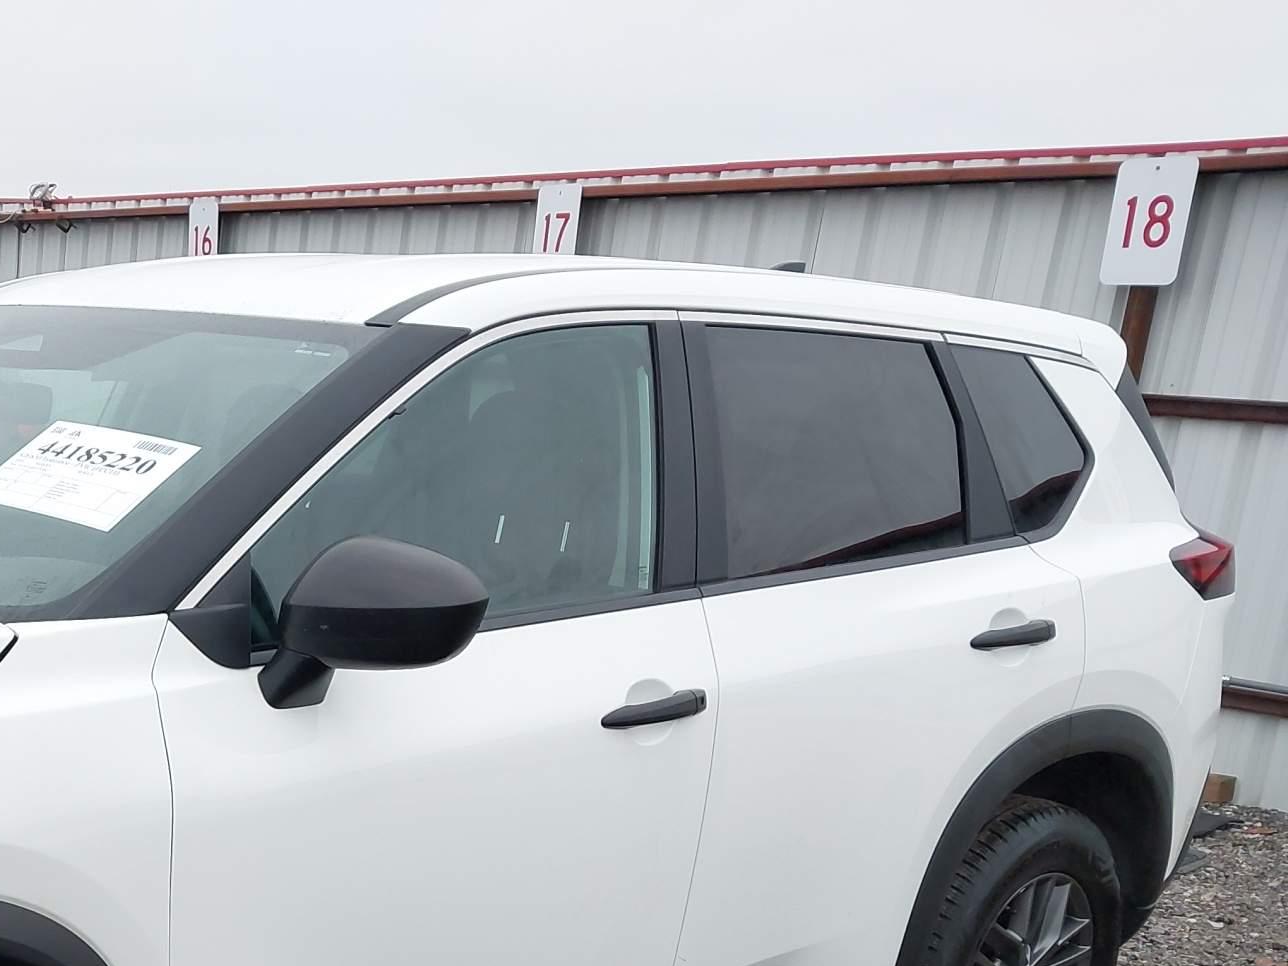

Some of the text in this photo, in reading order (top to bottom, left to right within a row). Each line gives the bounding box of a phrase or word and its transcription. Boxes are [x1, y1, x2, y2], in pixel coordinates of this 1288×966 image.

[193, 224, 213, 256] 16
[543, 212, 571, 253] 17
[1122, 194, 1175, 248] 18
[37, 440, 157, 475] 44185220
